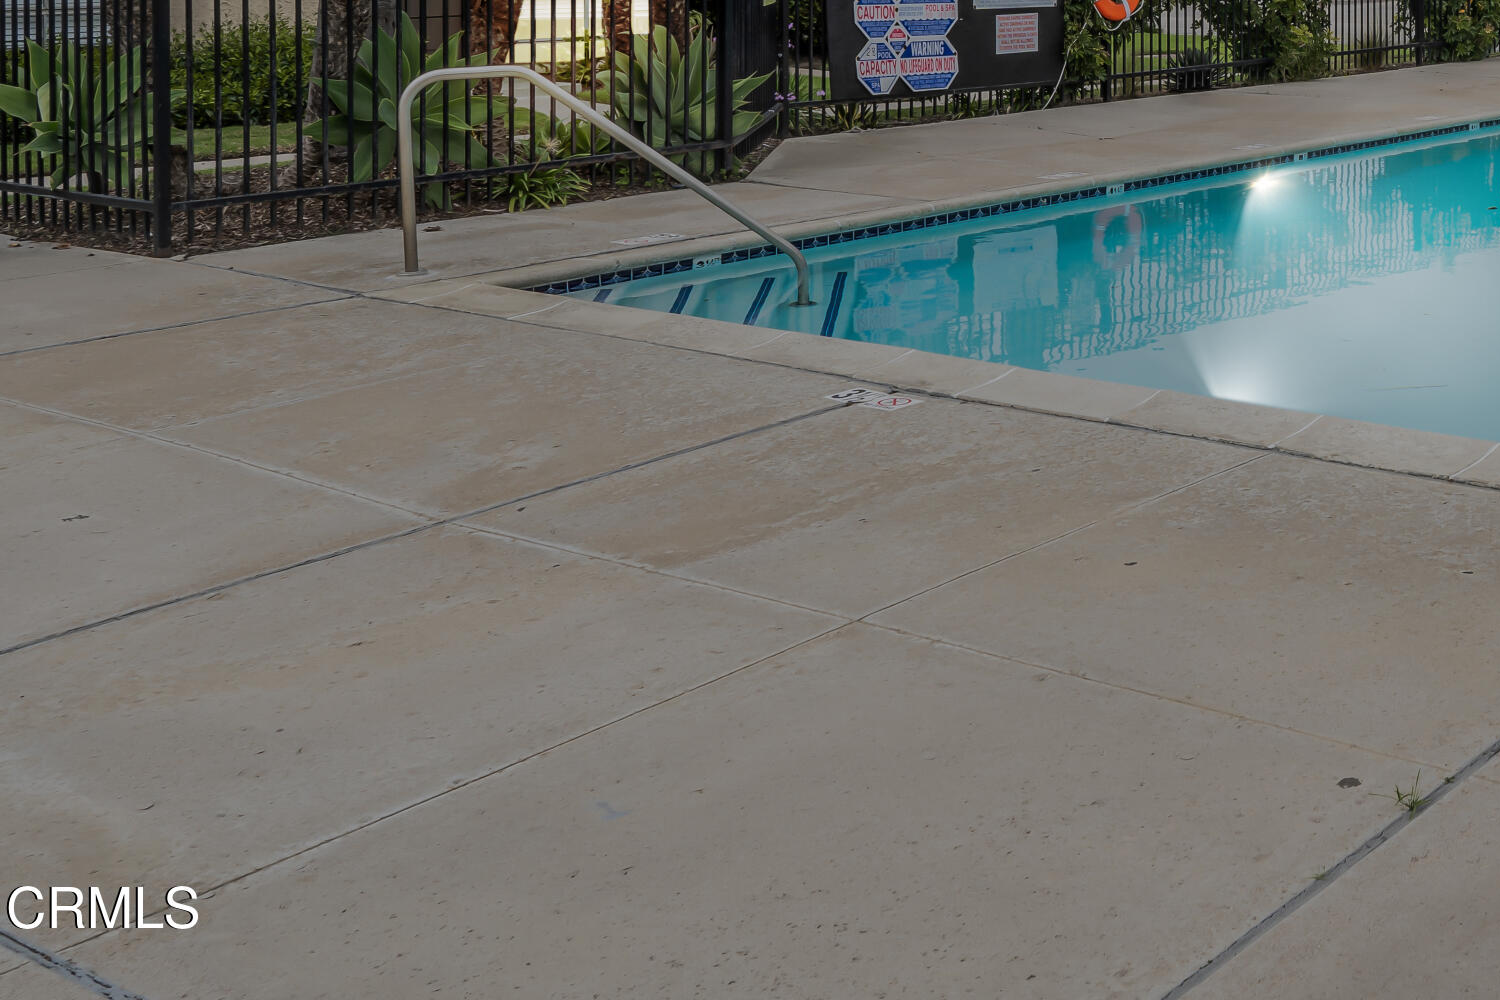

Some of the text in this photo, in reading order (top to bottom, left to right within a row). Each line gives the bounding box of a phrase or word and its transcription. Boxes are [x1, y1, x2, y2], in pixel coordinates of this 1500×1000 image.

[857, 5, 895, 19] CAUTION
[925, 4, 939, 12] POOL
[878, 51, 892, 59] POOL
[911, 41, 944, 57] WARNING
[859, 60, 897, 75] CAPACITY
[900, 57, 956, 74] NO LIFEGUARD ON DUTY
